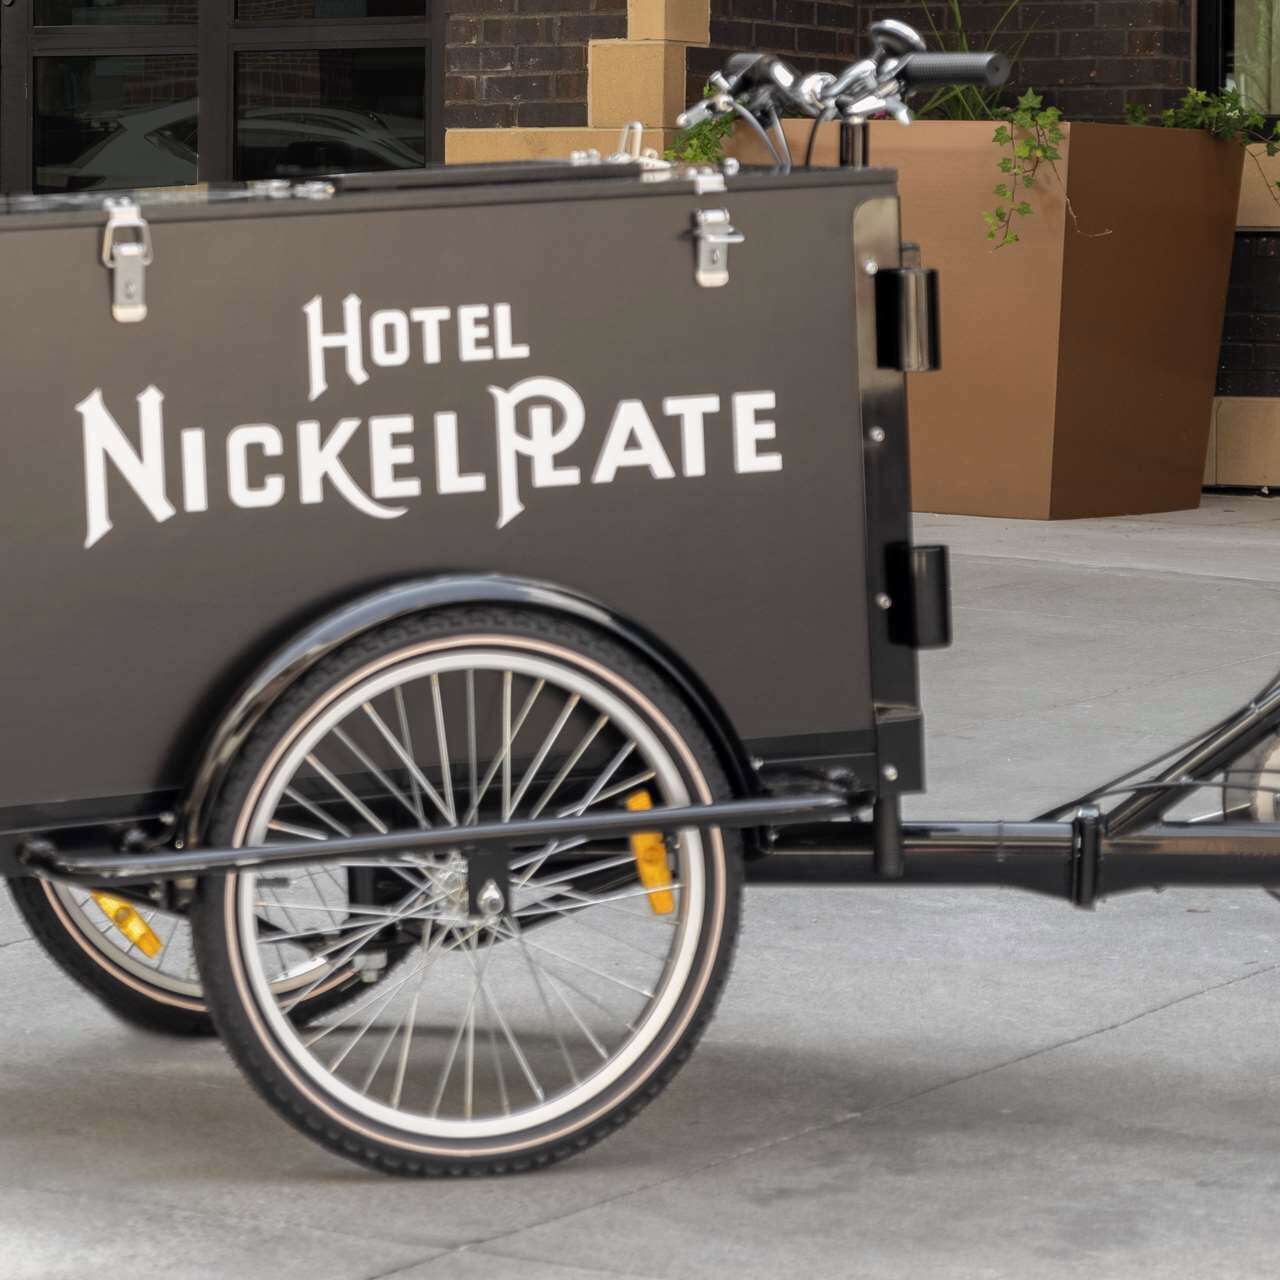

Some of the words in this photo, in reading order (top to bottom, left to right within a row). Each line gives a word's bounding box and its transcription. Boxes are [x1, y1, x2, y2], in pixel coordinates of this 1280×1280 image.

[302, 293, 530, 402] HOTEL
[74, 384, 487, 549] NICKEL
[486, 375, 783, 530] PLATE
